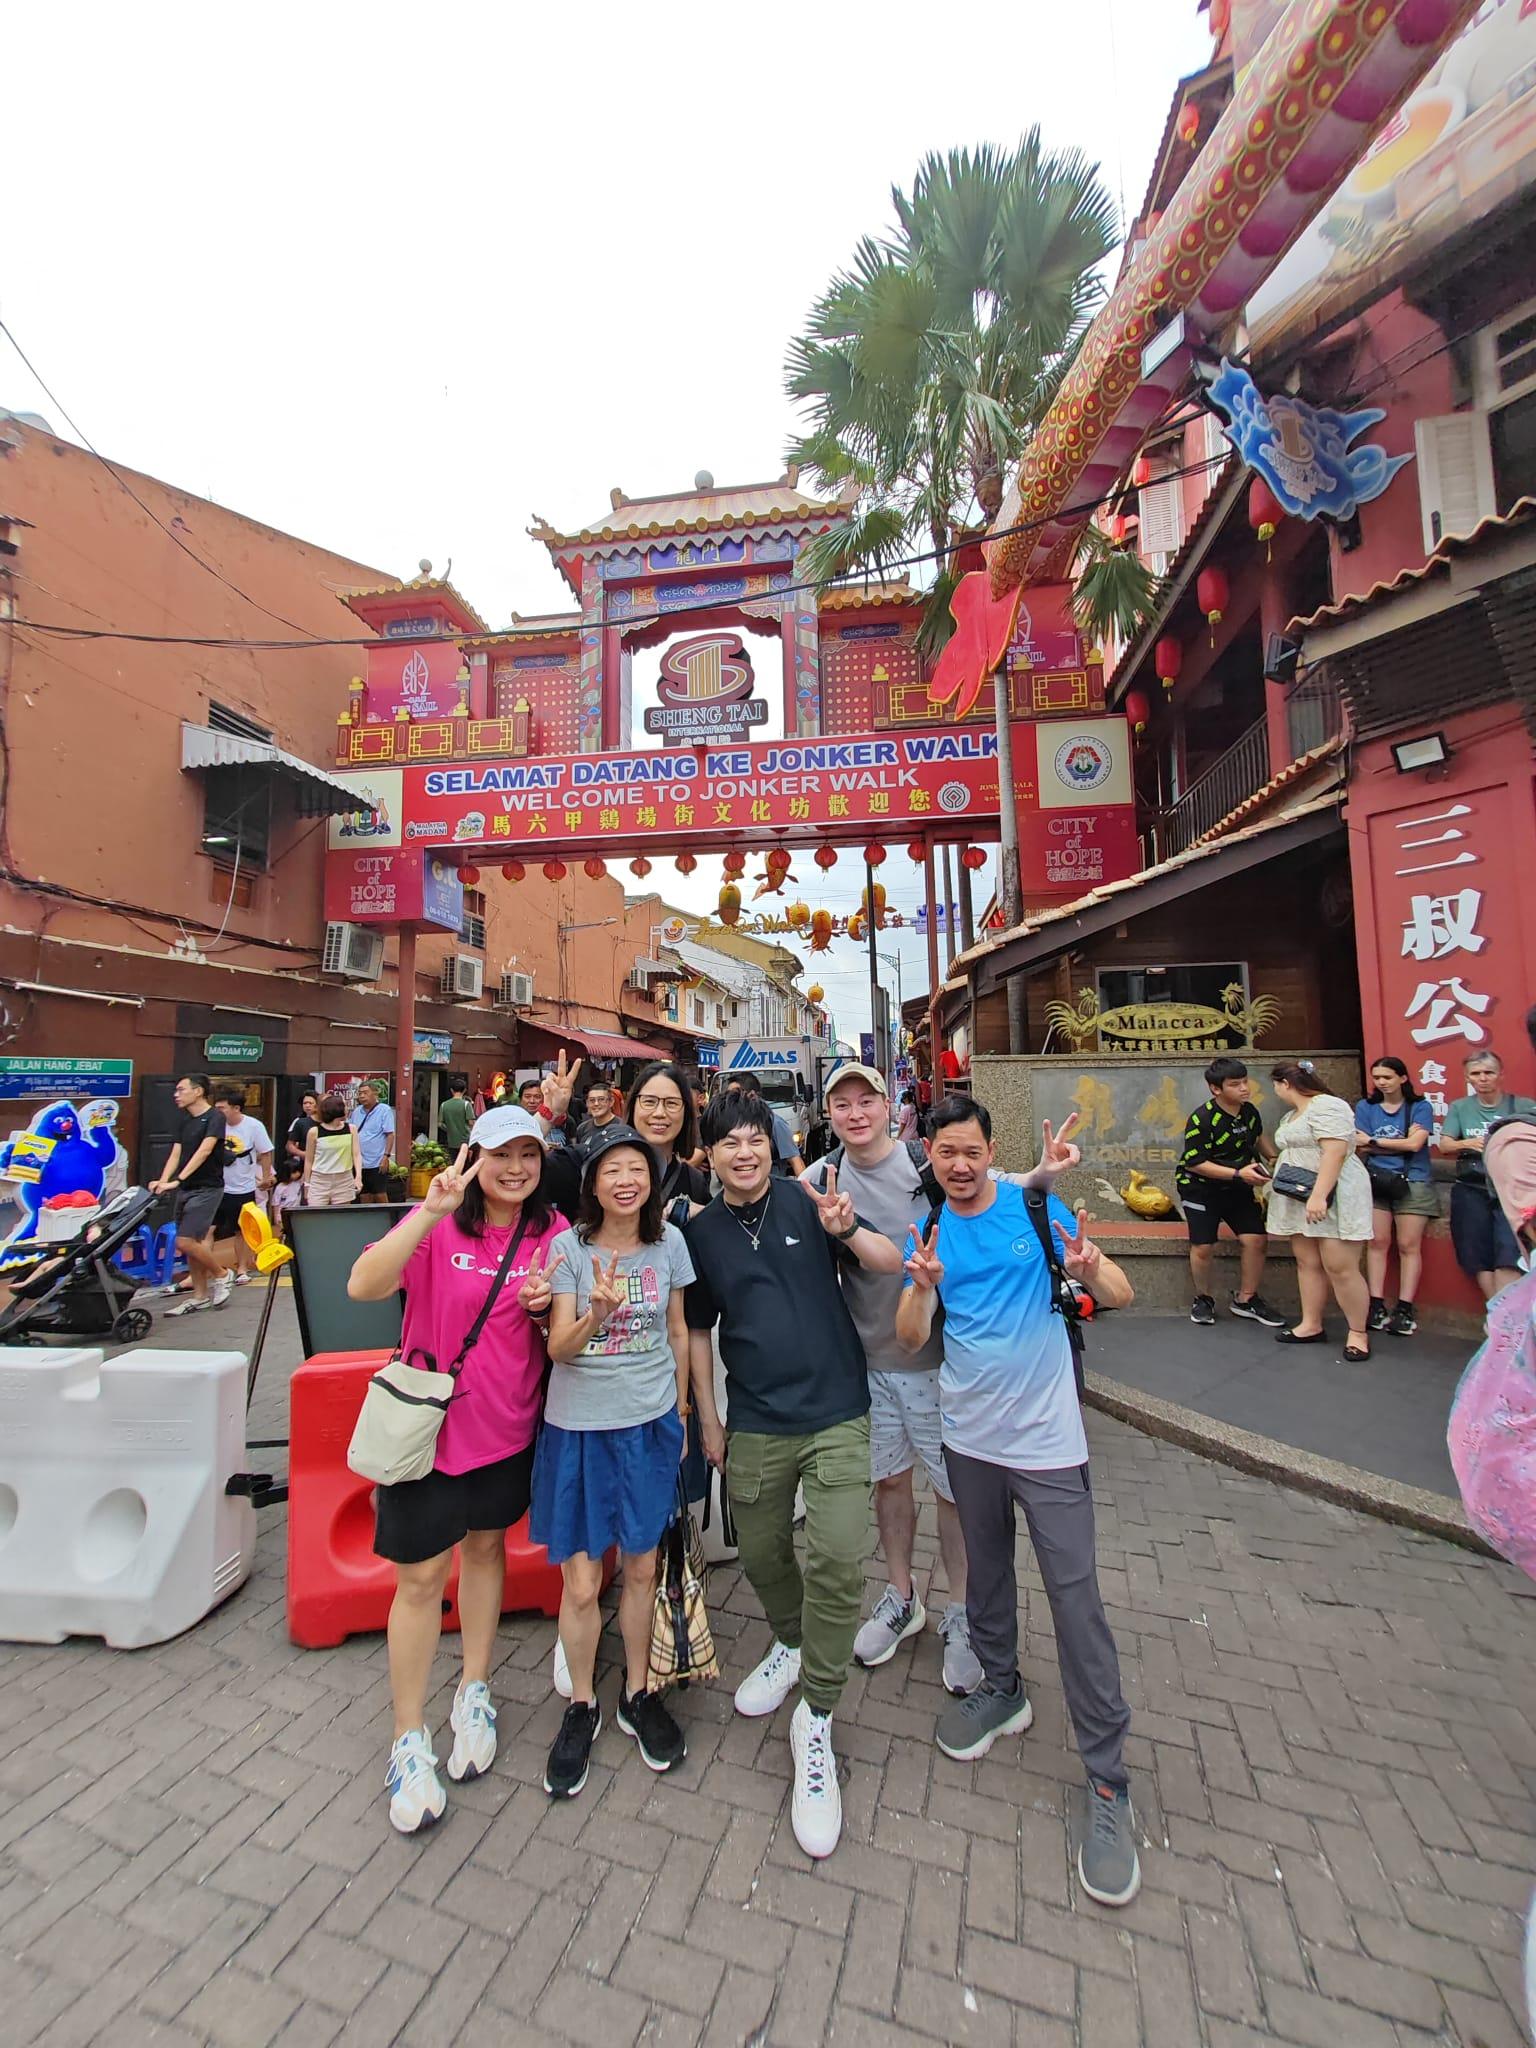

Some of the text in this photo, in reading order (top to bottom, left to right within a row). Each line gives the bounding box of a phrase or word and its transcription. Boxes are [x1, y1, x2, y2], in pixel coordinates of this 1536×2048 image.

[650, 702, 763, 728] SHENG TAI
[668, 723, 744, 737] INTERNATIONAL
[426, 735, 999, 794] SELAMAT DATANG KE JONKER WALK
[501, 768, 920, 812] WELCOME TO JONKER WALK
[416, 828, 448, 836] MADANI
[1047, 816, 1098, 835] CITY
[1065, 835, 1083, 849] of
[354, 856, 394, 873] CITY
[1045, 848, 1104, 867] HOPE
[367, 872, 381, 885] of
[350, 885, 397, 901] HOPE
[1394, 803, 1491, 1045] 三叔公
[1117, 1015, 1206, 1030] Malacca
[208, 1046, 258, 1056] MADAM YAP
[7, 1060, 104, 1071] JALAN HANG JEBAT
